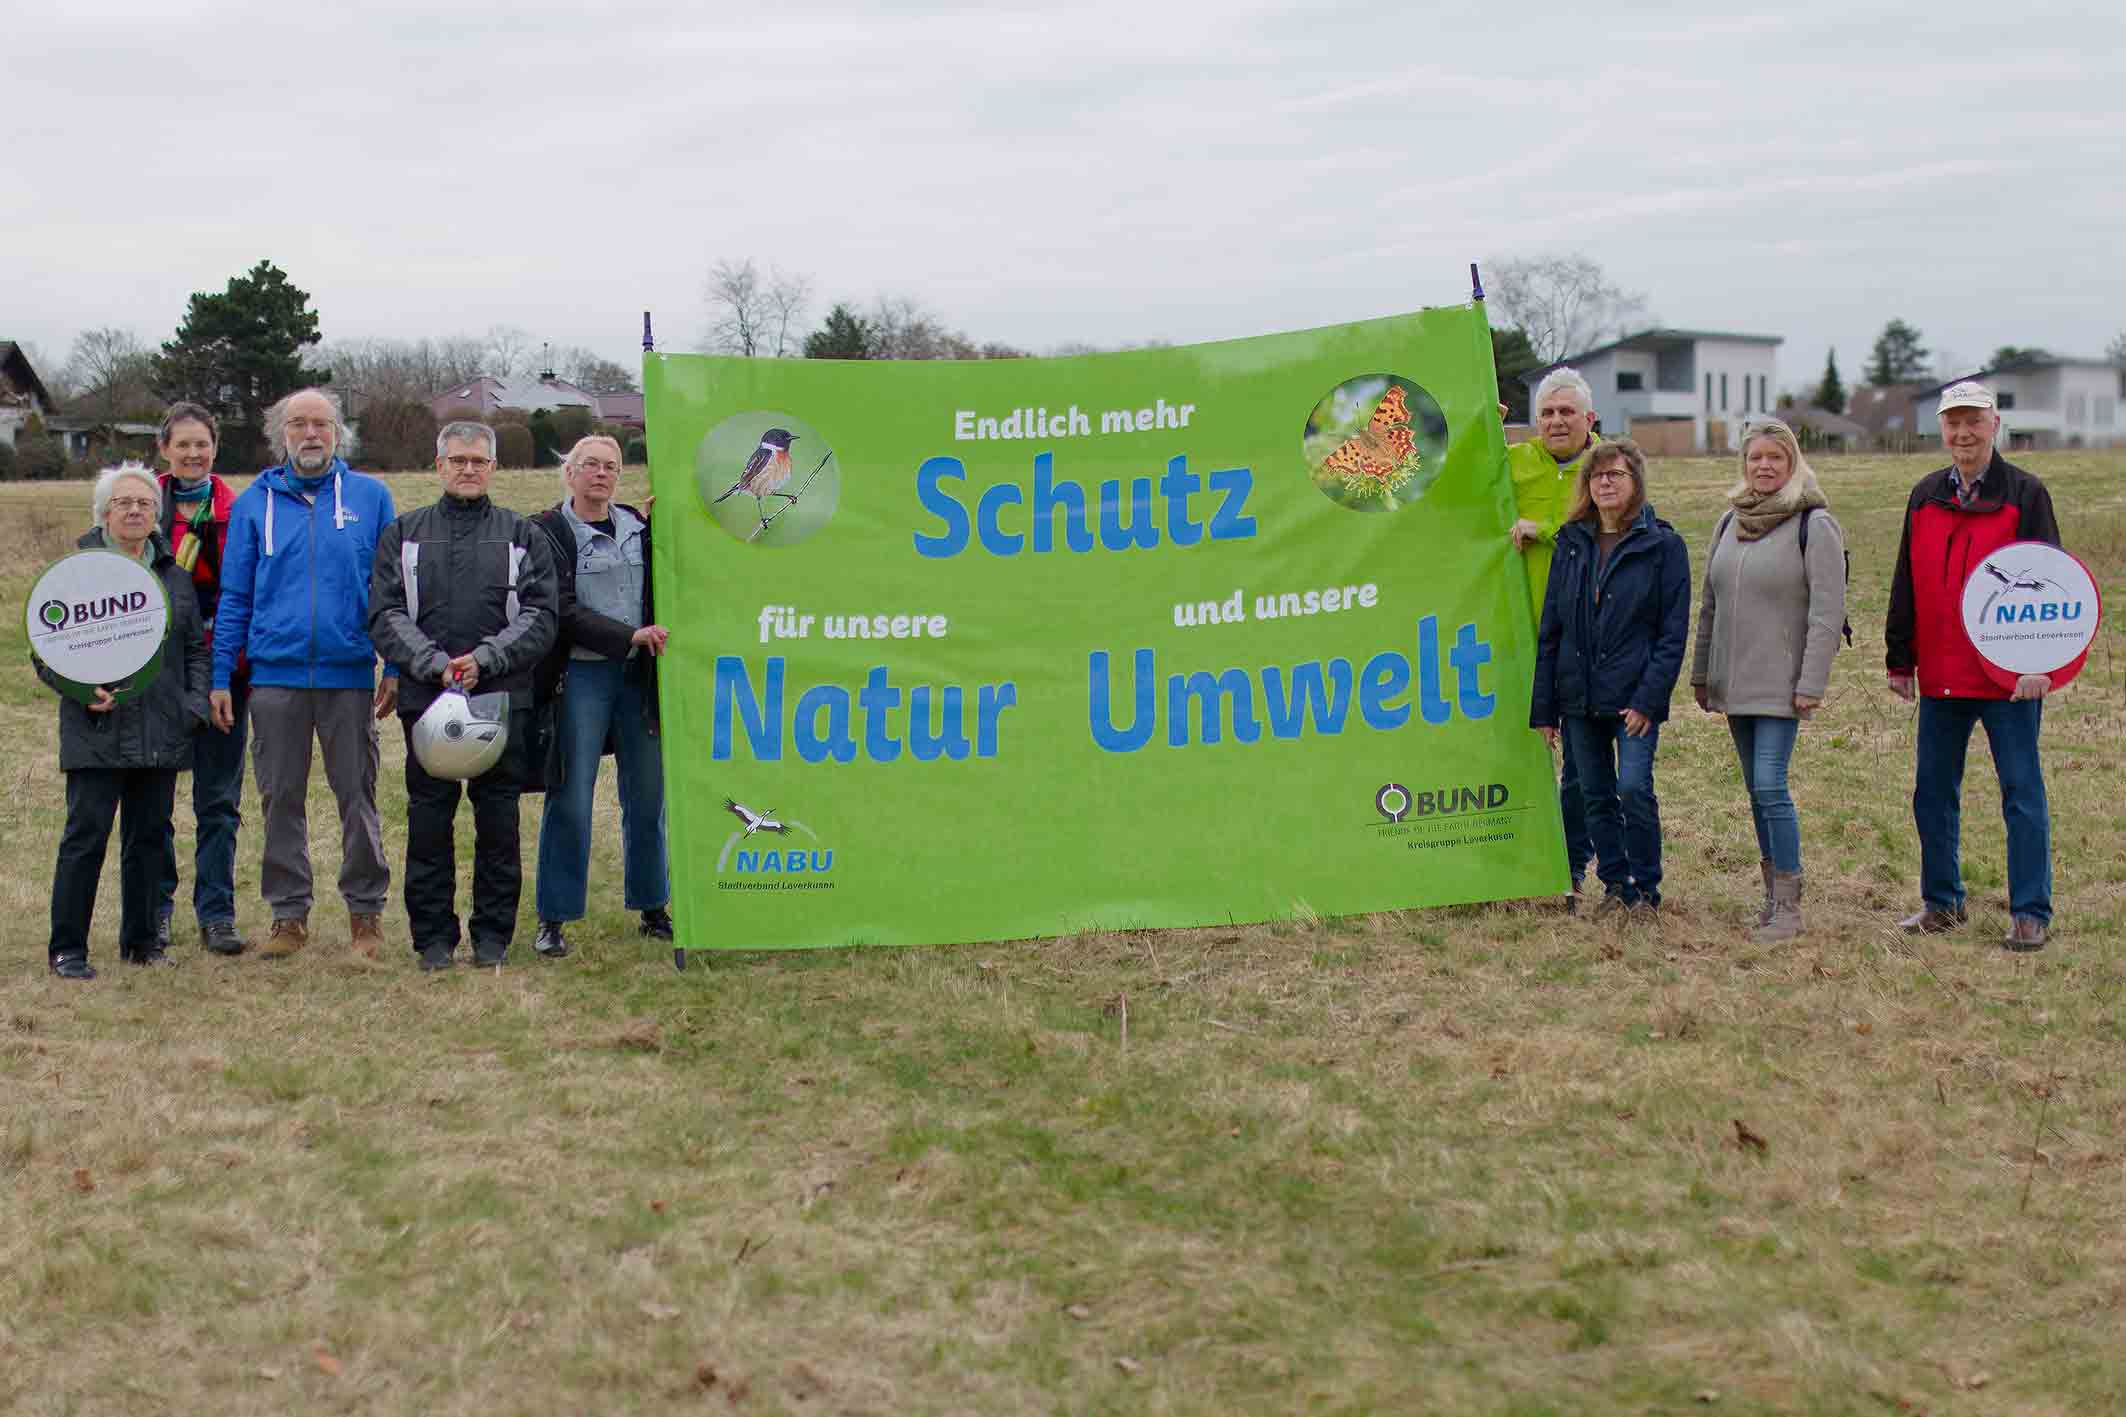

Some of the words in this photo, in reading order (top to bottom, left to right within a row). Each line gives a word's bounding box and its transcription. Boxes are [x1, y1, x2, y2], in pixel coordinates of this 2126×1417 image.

[954, 404, 1091, 441] Endlich
[1101, 398, 1196, 434] mehr
[912, 451, 1257, 560] Schutz
[73, 591, 147, 625] BUND
[1173, 589, 1246, 627] und
[1255, 582, 1379, 620] unsere
[1996, 601, 2082, 624] NABU
[757, 605, 815, 643] für
[823, 611, 948, 640] unsere
[711, 655, 1017, 765] Natur
[1088, 614, 1496, 753] Umwelt
[1416, 783, 1509, 817] BUND
[736, 848, 833, 873] NABU
